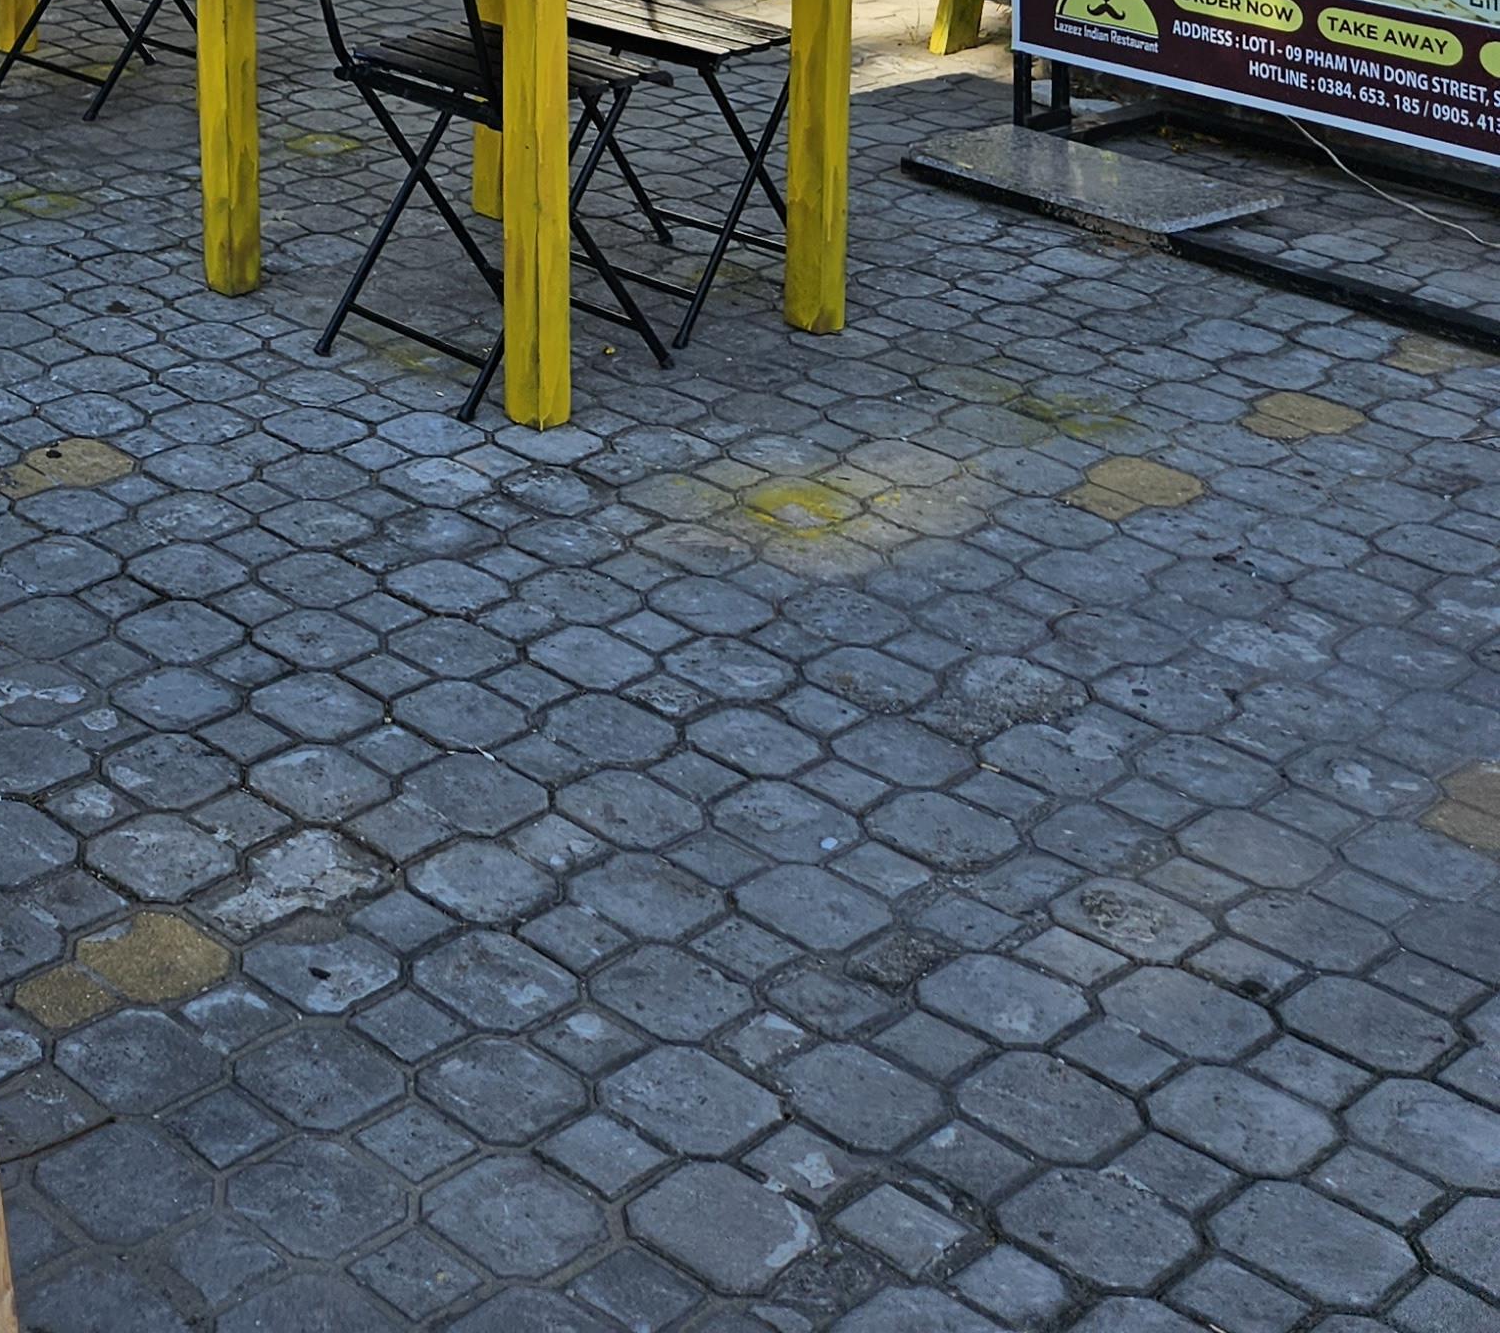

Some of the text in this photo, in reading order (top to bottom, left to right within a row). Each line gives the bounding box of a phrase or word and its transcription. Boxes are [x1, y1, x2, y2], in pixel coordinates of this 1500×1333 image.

[1054, 17, 1159, 53] Lazeez Indian Restaurant
[1326, 16, 1448, 55] TAKE AWAY
[1242, 34, 1266, 53] LOT
[1285, 44, 1302, 62] 09
[1305, 48, 1348, 72] PHAM
[1350, 57, 1380, 80] VAN
[1383, 64, 1428, 91] DONG
[1431, 76, 1490, 107] STREET,
[1317, 76, 1357, 100] 0384.
[1359, 85, 1391, 108] 653.
[1393, 94, 1421, 115] 185
[1432, 102, 1474, 128] 0905.
